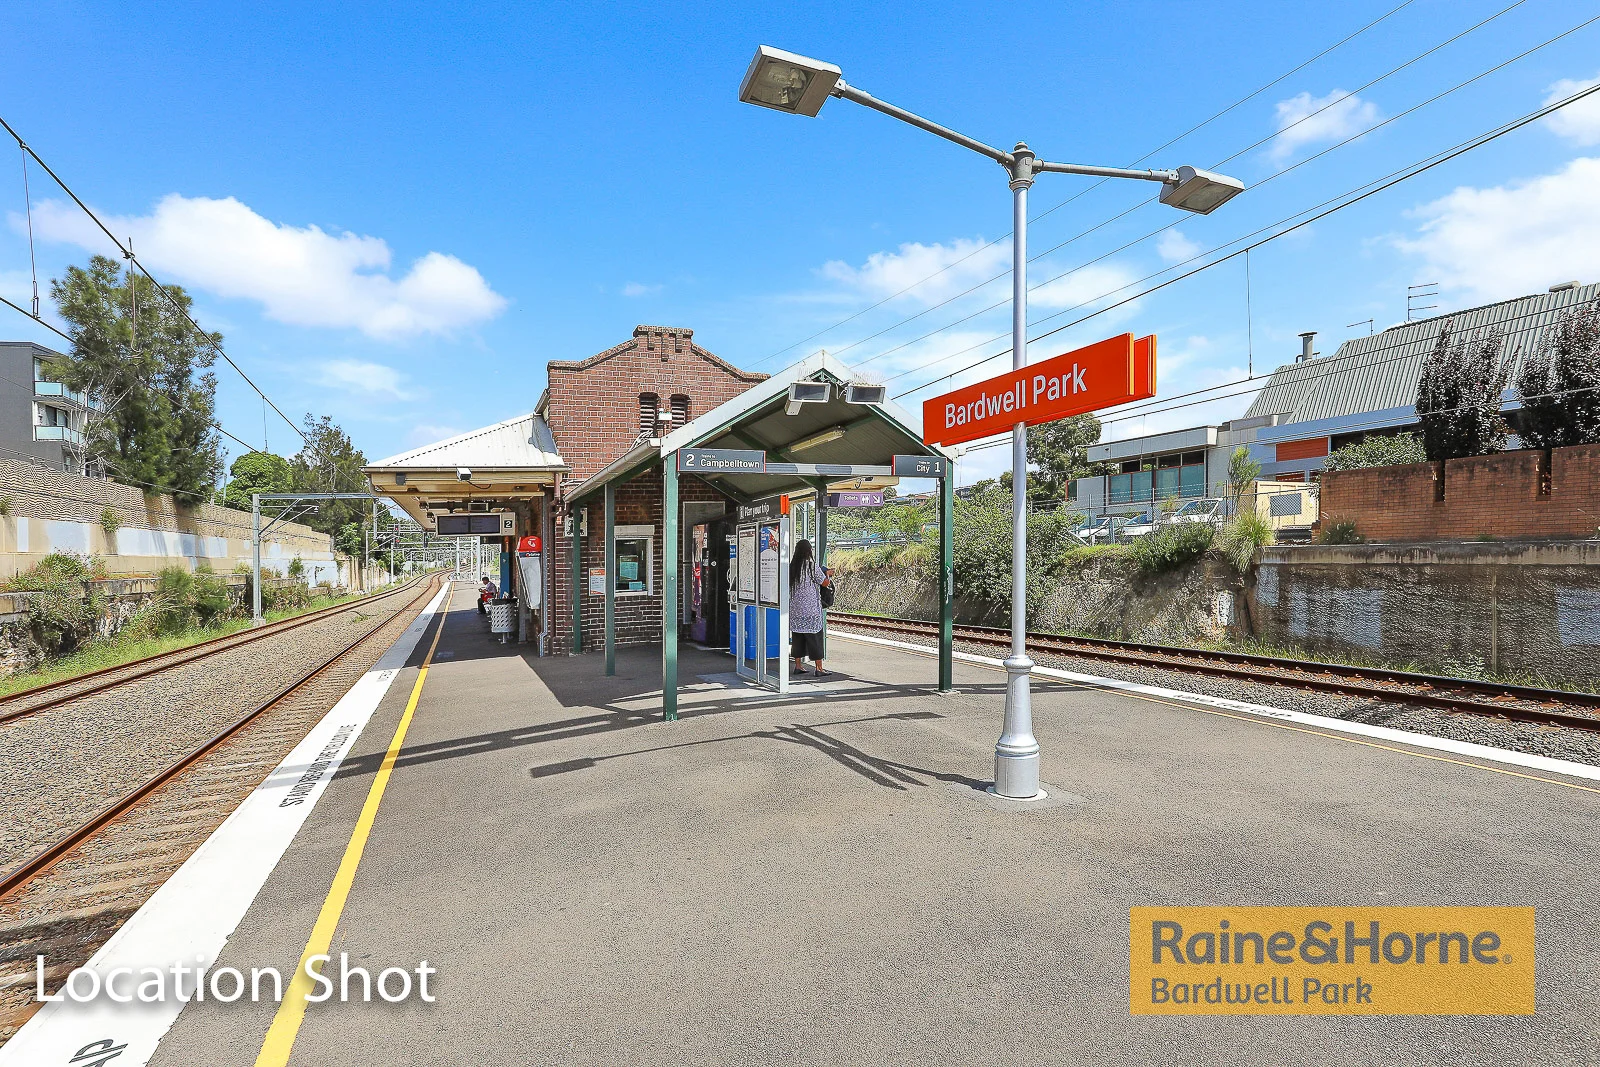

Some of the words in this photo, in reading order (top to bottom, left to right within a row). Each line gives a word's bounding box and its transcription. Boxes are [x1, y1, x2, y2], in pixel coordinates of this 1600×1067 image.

[945, 379, 1026, 429] Bardwell
[1033, 363, 1087, 405] Park
[685, 454, 695, 467] 2
[700, 458, 760, 469] Campbelltown
[916, 464, 930, 474] City
[934, 461, 941, 473] 1
[505, 520, 511, 528] 2
